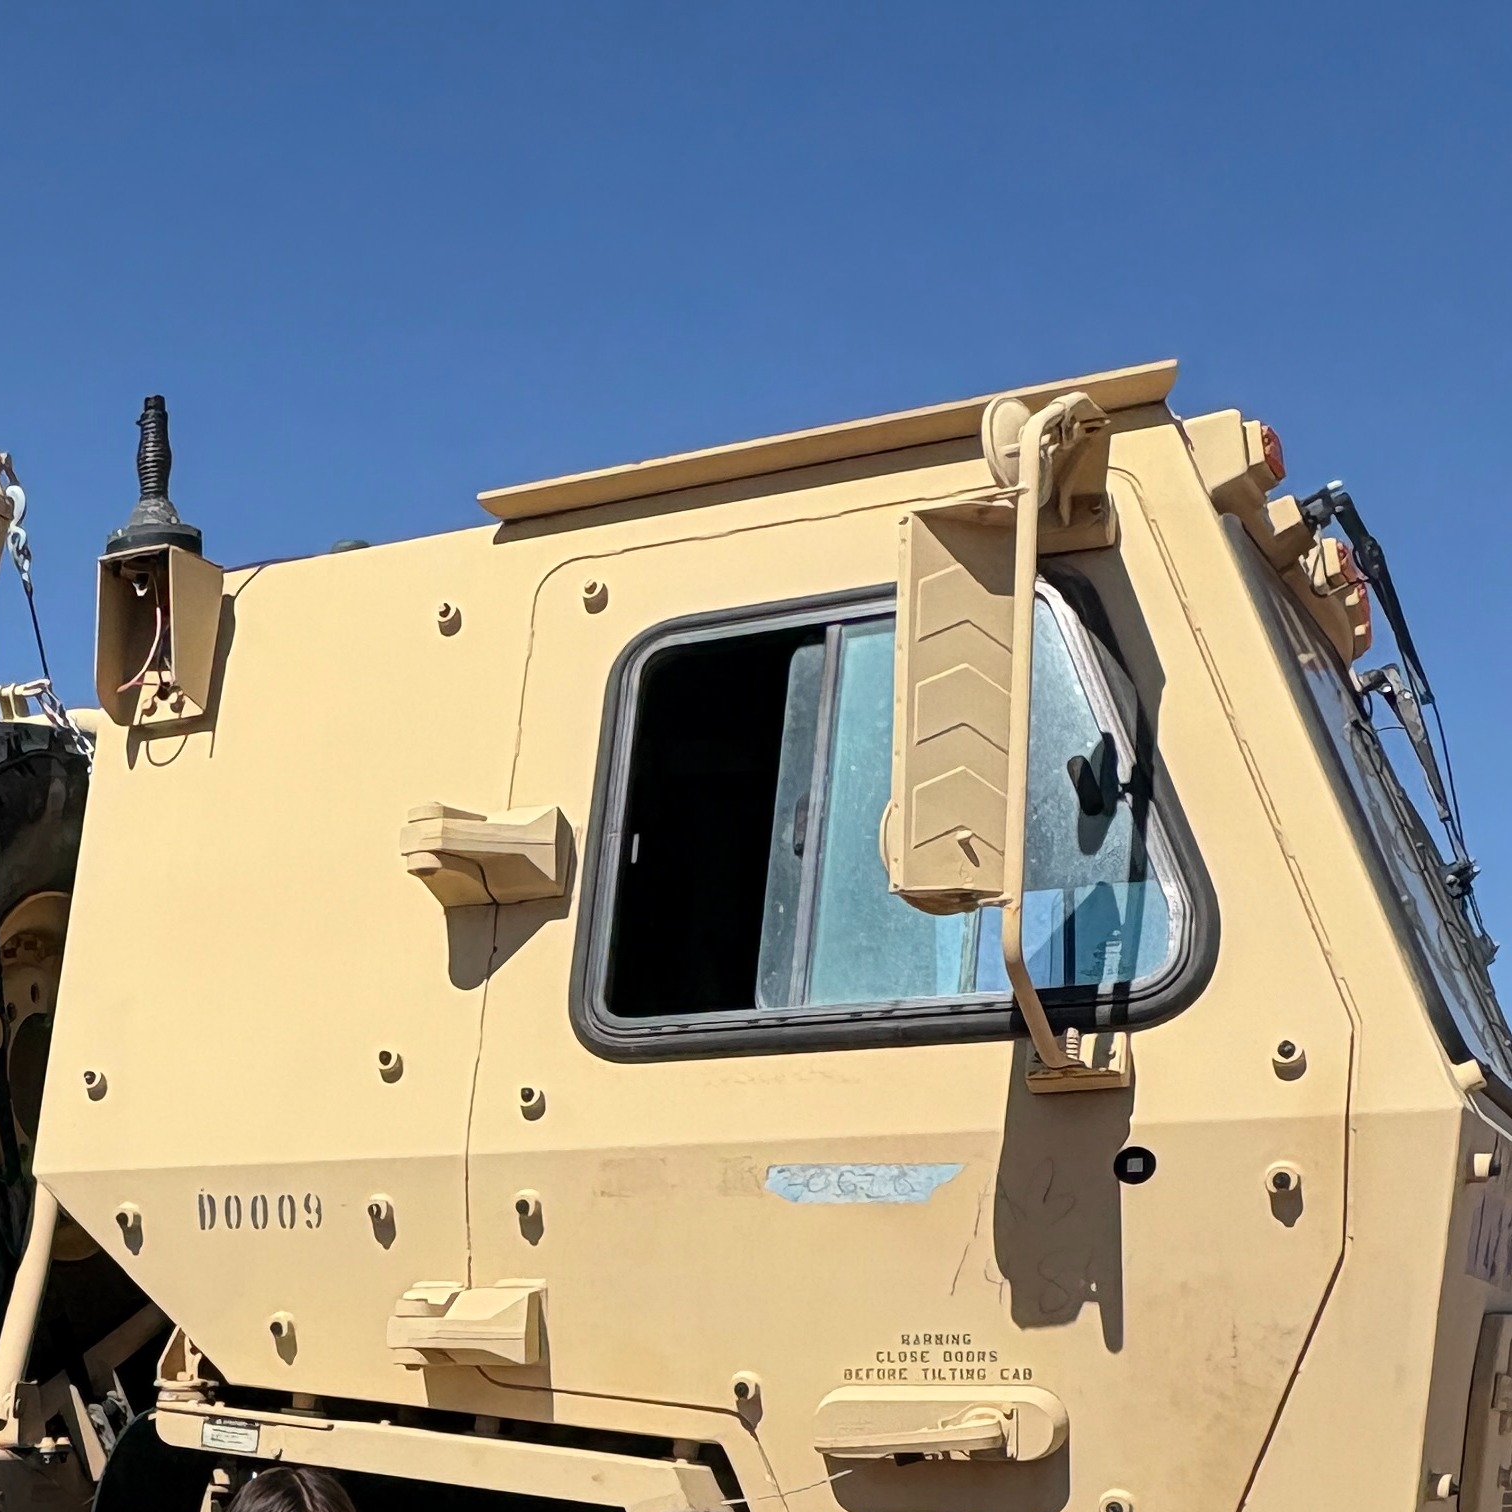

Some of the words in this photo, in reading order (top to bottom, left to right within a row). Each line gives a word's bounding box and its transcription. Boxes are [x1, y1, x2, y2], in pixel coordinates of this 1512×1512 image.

[198, 1192, 322, 1231] D0009
[876, 1350, 931, 1364] CLOSE
[943, 1350, 999, 1363] DOORS
[843, 1367, 909, 1381] BEFORE
[921, 1367, 987, 1381] TILTING
[999, 1367, 1033, 1381] CAB
